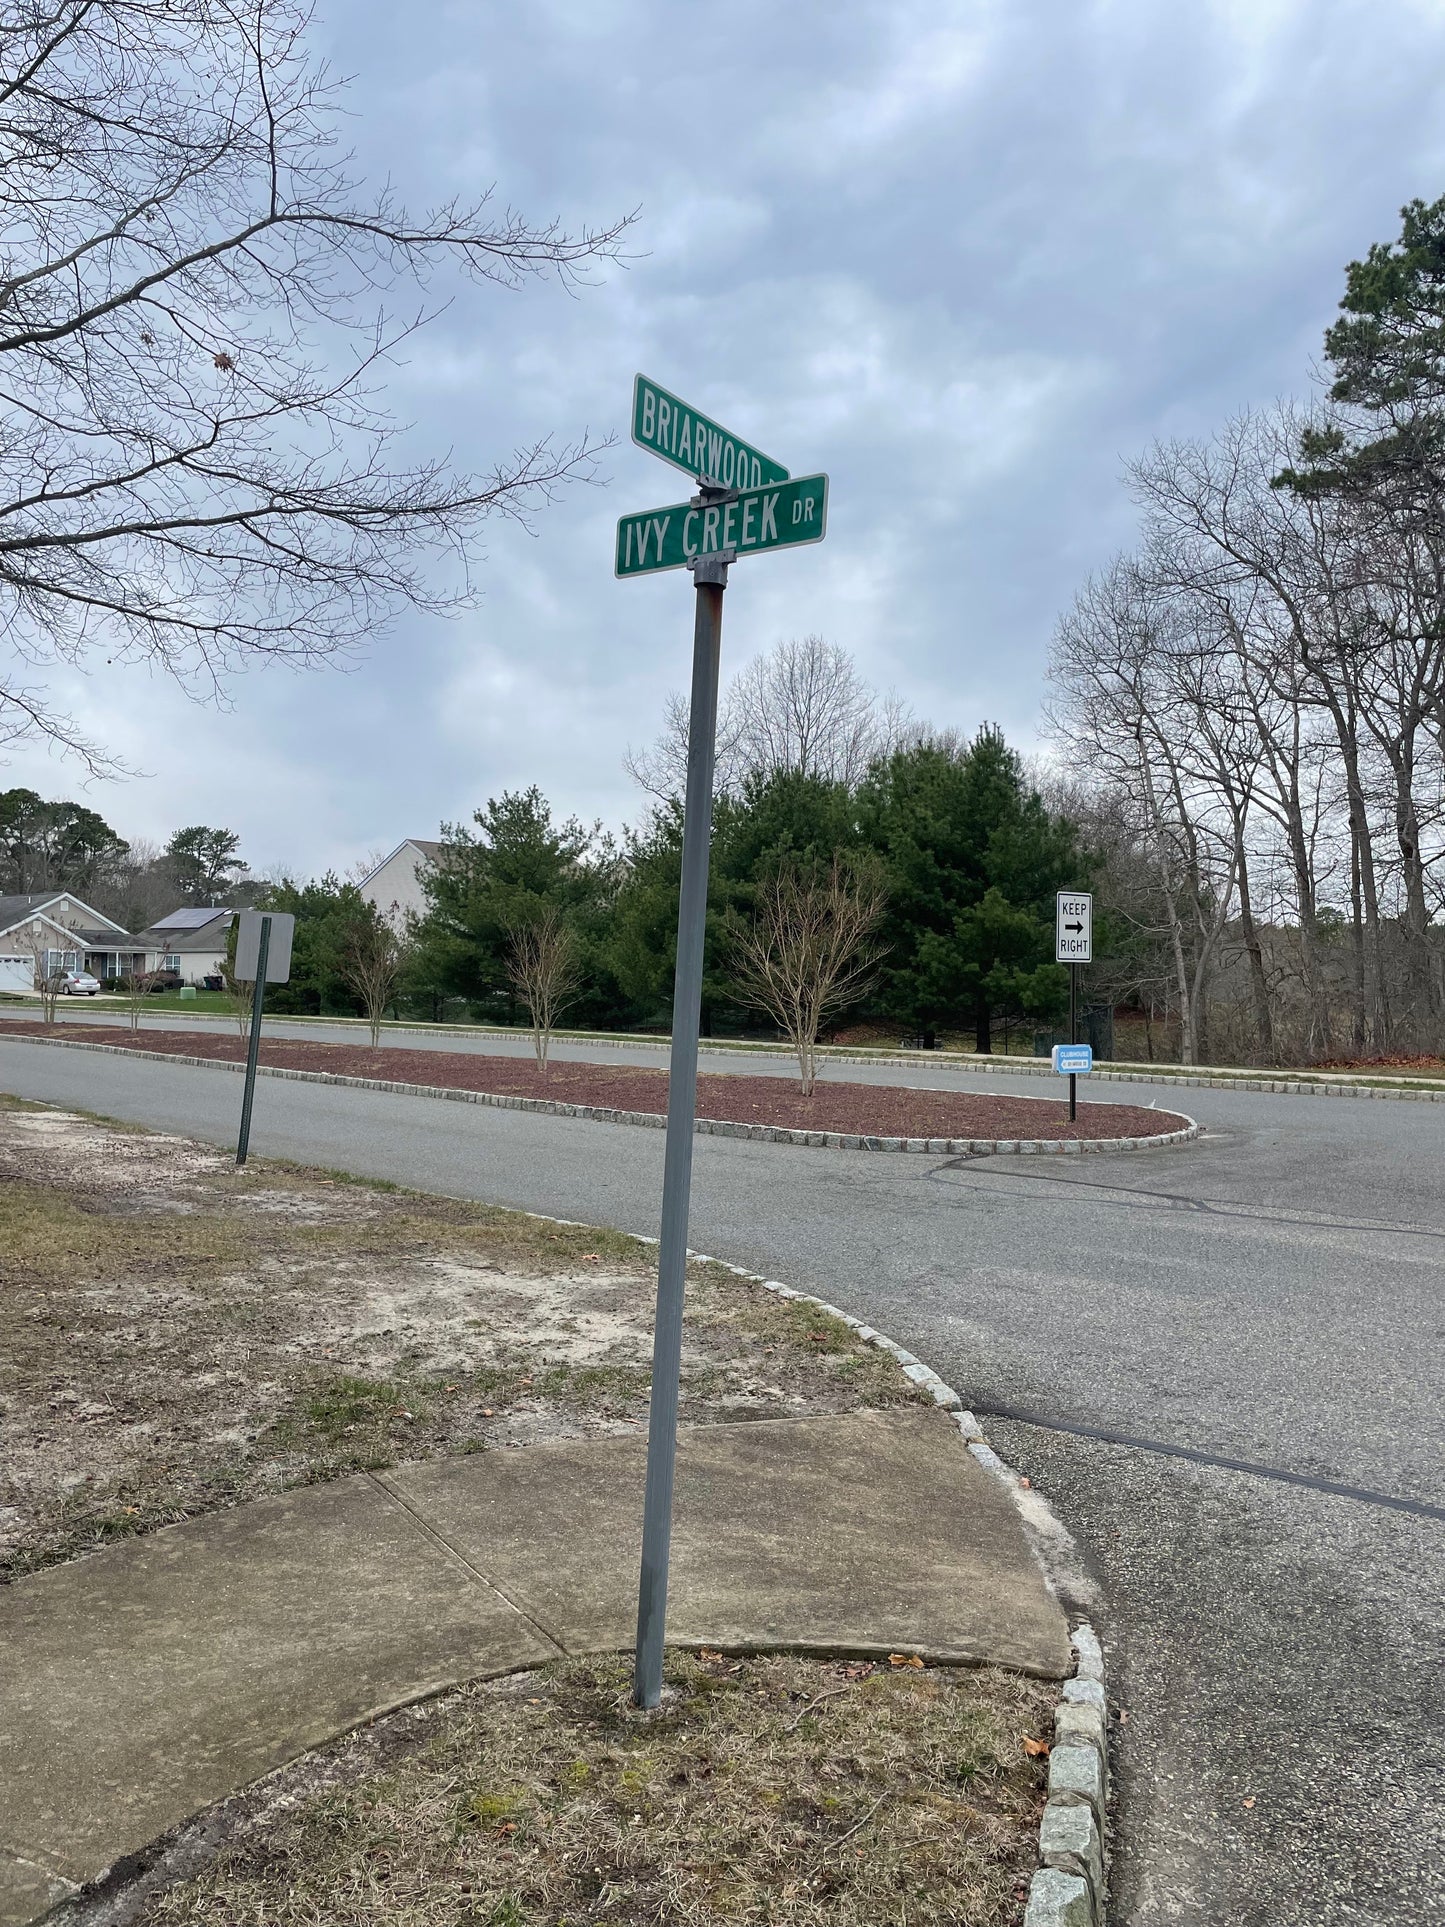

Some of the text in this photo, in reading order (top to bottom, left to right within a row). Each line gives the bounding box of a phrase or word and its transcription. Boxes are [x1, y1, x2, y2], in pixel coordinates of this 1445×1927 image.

[641, 387, 762, 490] BRIARWOOD
[625, 492, 815, 567] IVY CREEK DR
[1062, 902, 1087, 916] KEEP
[1060, 939, 1088, 953] RIGHT
